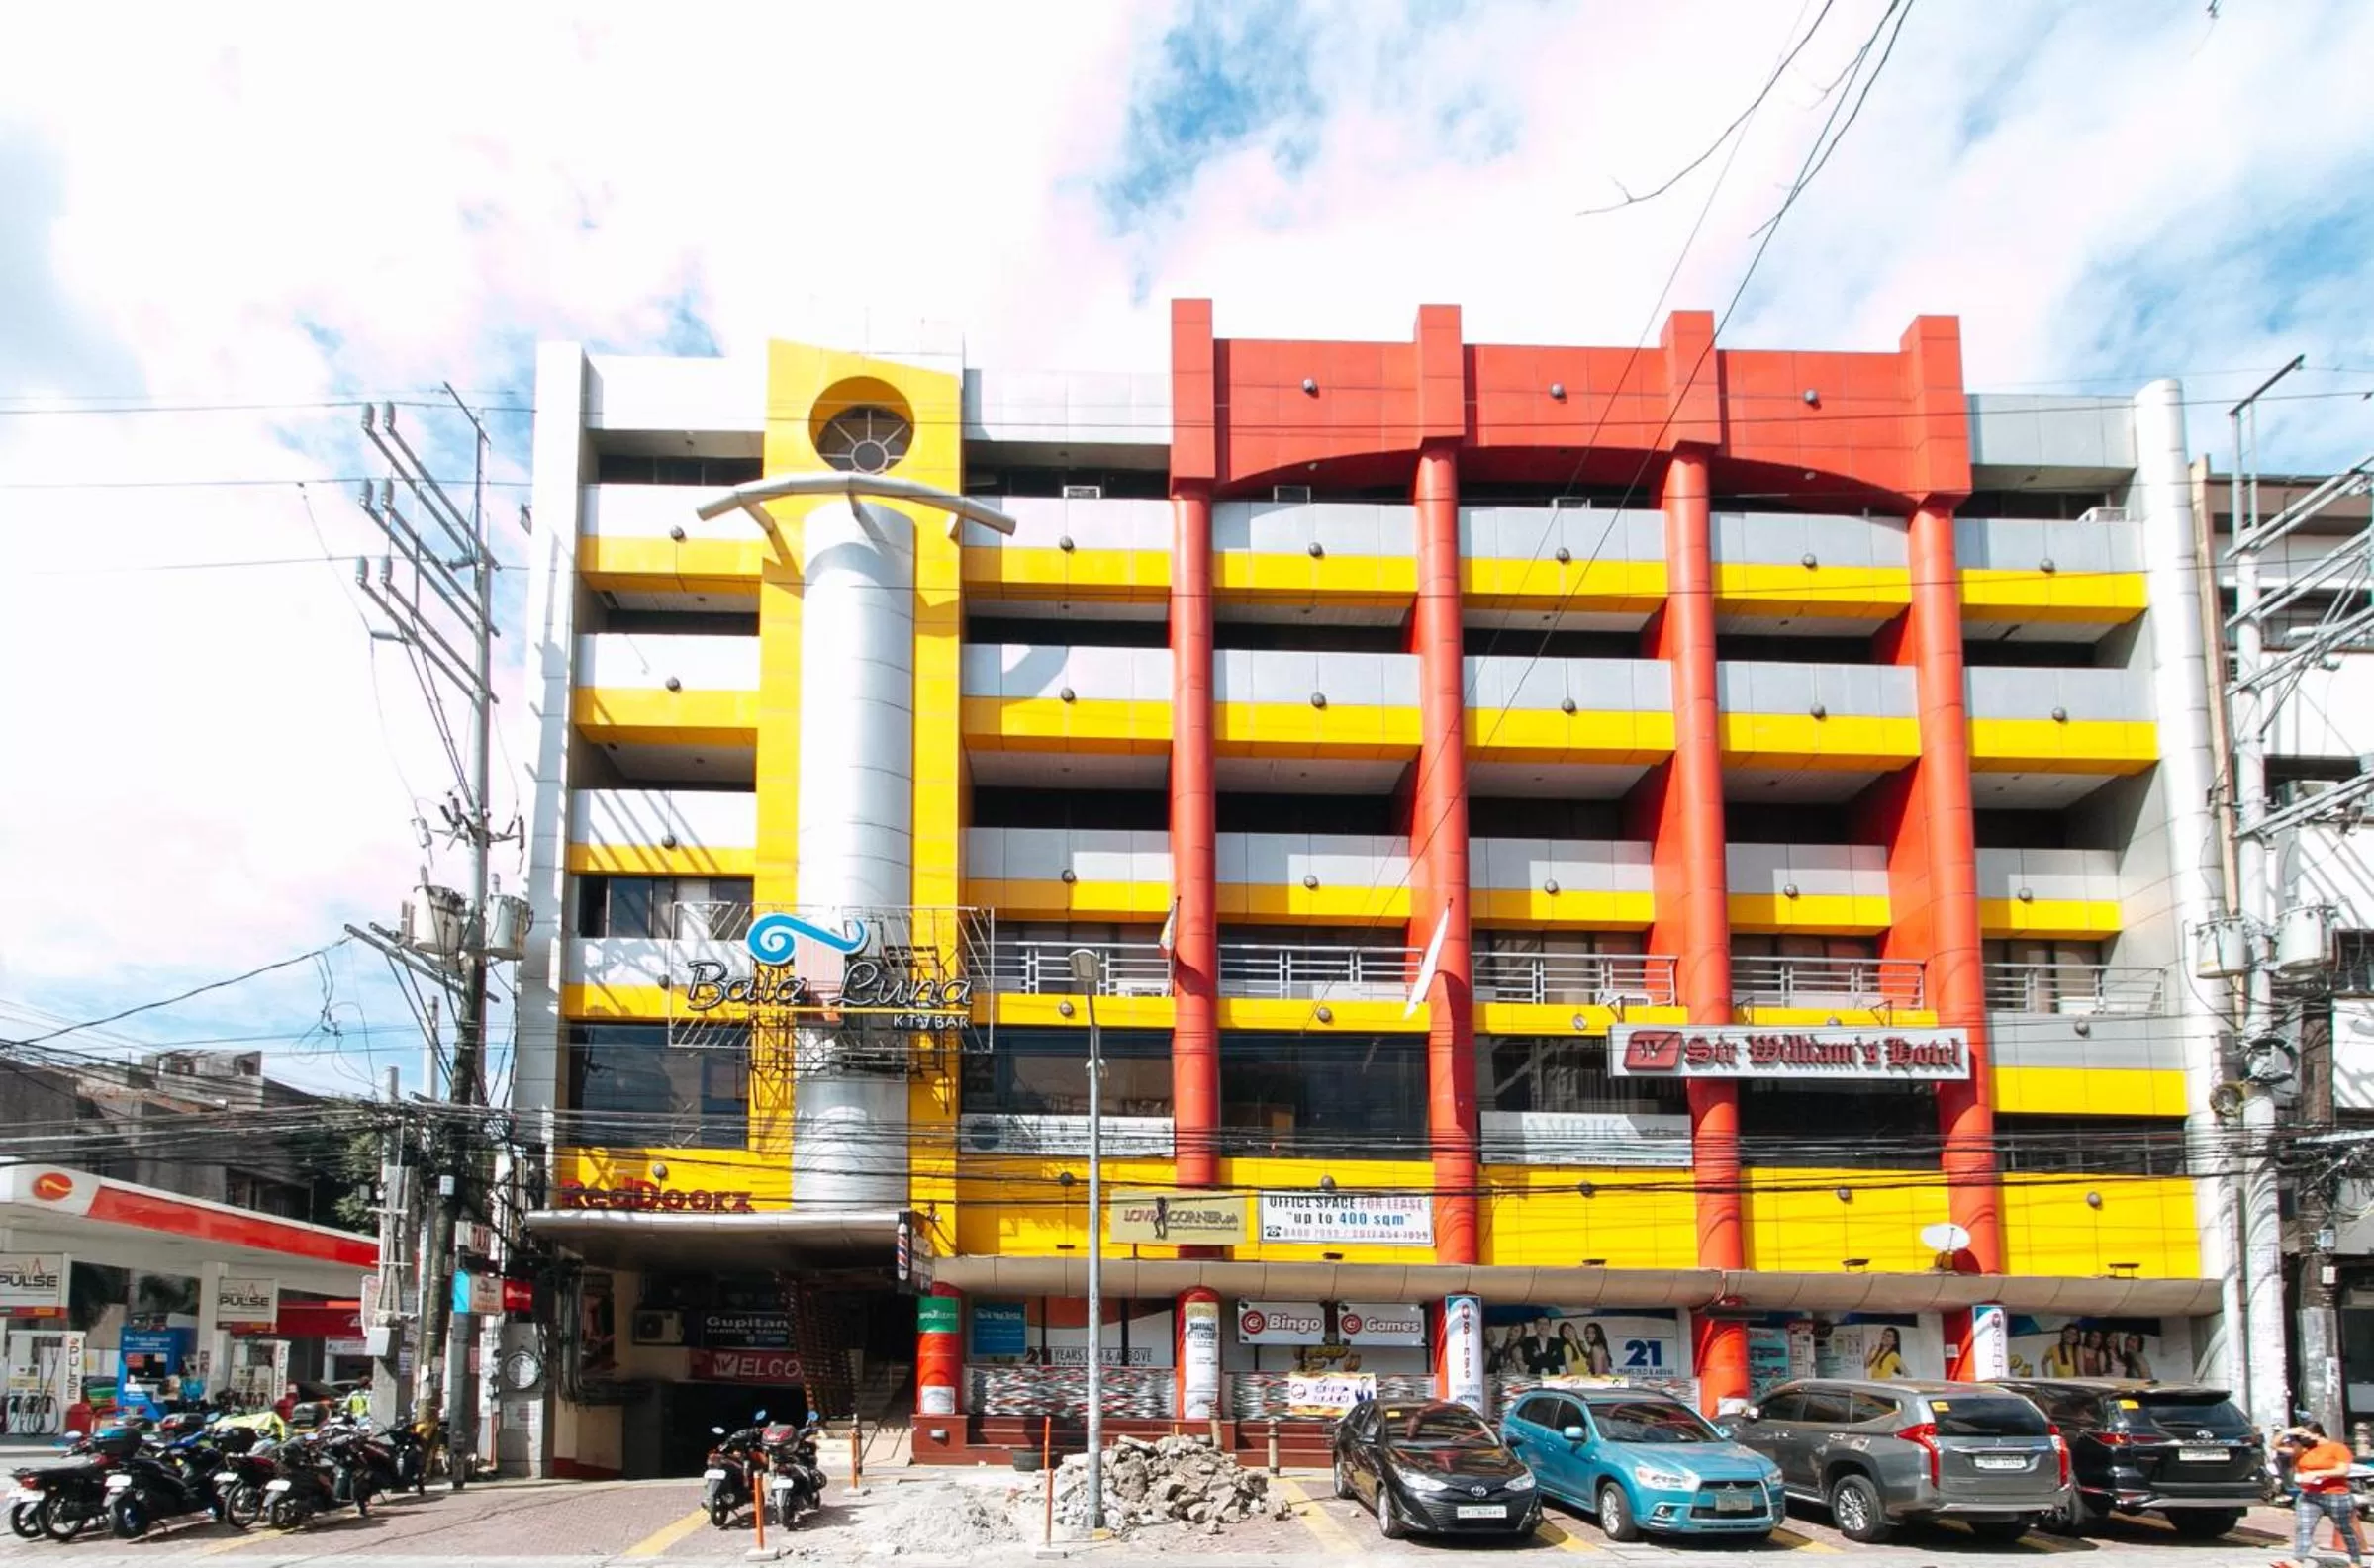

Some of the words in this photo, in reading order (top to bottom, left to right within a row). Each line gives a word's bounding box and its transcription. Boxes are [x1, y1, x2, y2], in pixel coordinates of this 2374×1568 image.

[688, 959, 808, 1011] Baia
[827, 961, 974, 1007] Luna
[933, 1013, 970, 1030] BAR
[1684, 1035, 1739, 1065] Sir
[1746, 1033, 1880, 1066] William's
[1884, 1036, 1963, 1068] Hotel
[561, 1177, 756, 1213] RedDoorz
[1269, 1195, 1312, 1209] OFFICE
[1315, 1195, 1355, 1210] SPACE
[1359, 1196, 1385, 1210] FOR
[1386, 1197, 1424, 1211] LEASE
[1318, 1212, 1333, 1225] to
[1339, 1212, 1368, 1225] 400
[0, 1274, 57, 1287] PULSE
[219, 1296, 270, 1307] PULSE
[705, 1315, 790, 1330] Gupitan
[1267, 1313, 1322, 1336] Bingo
[1364, 1317, 1420, 1333] Games
[1054, 1348, 1084, 1362] YEARS
[1624, 1339, 1663, 1367] 21
[713, 1353, 806, 1378] WELCO
